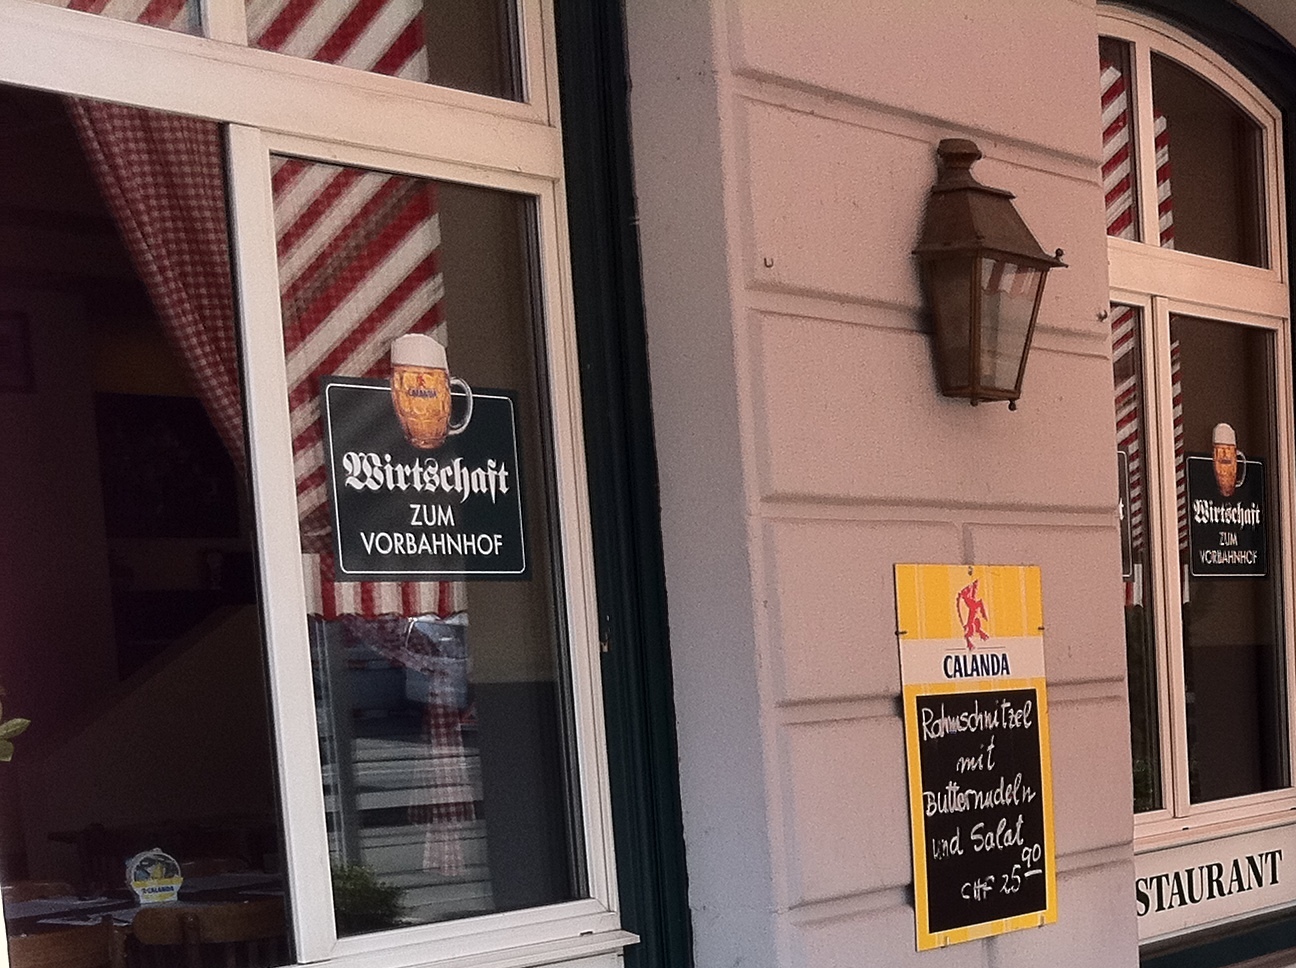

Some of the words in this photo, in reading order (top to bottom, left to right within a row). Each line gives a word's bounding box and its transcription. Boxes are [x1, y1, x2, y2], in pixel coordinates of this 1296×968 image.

[342, 452, 510, 504] Wirtschaft
[409, 504, 456, 527] ZUM
[1192, 499, 1261, 531] Wirtschaft
[360, 532, 503, 555] VORBAHNHOF
[1219, 531, 1238, 546] ZUM
[1200, 550, 1258, 565] VORBAHNHOF
[943, 653, 1010, 679] CALANDA
[956, 735, 996, 773] mit
[970, 814, 1024, 852] Salat
[1135, 849, 1282, 916] STAURANT
